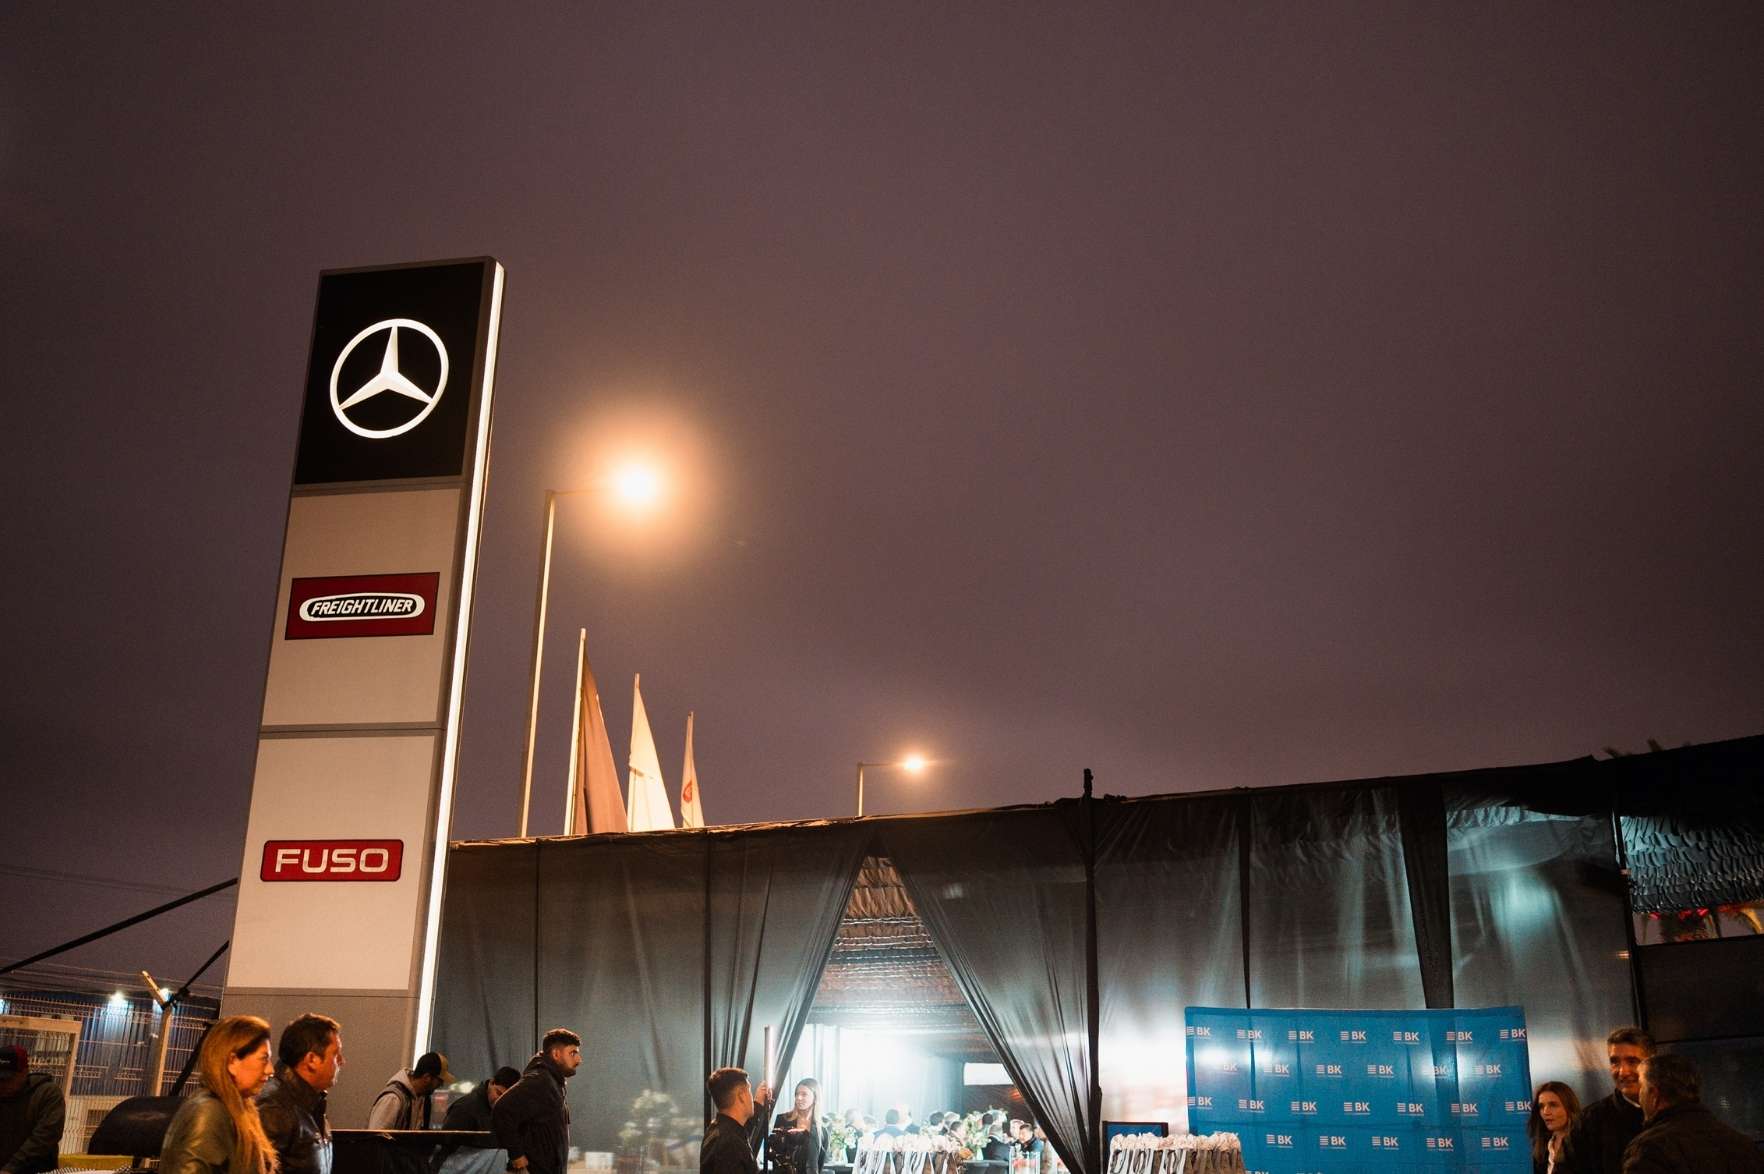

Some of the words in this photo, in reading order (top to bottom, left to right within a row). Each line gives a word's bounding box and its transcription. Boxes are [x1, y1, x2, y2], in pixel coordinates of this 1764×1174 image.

[310, 599, 413, 615] FREIGHTLINER
[275, 848, 389, 873] FUSO
[1196, 1027, 1211, 1036] BK
[1248, 1030, 1262, 1039] BK
[1300, 1031, 1314, 1040] BK
[1352, 1031, 1366, 1040] BK
[1511, 1029, 1526, 1038] BK
[1404, 1032, 1419, 1041] BK
[1458, 1032, 1472, 1041] BK
[1275, 1064, 1289, 1073] BK
[1328, 1065, 1342, 1074] BK
[1379, 1066, 1392, 1074] BK
[1486, 1065, 1500, 1074] BK
[1198, 1097, 1212, 1106] BK
[1250, 1100, 1264, 1109] BK
[1302, 1102, 1317, 1110] BK
[1517, 1102, 1532, 1110] BK
[1355, 1102, 1370, 1112] BK
[1408, 1104, 1424, 1112] BK
[1462, 1104, 1478, 1112] BK
[1278, 1135, 1292, 1144] BK
[1331, 1136, 1346, 1146] BK
[1384, 1137, 1398, 1146] BK
[1438, 1138, 1453, 1148] BK
[1493, 1137, 1508, 1146] BK
